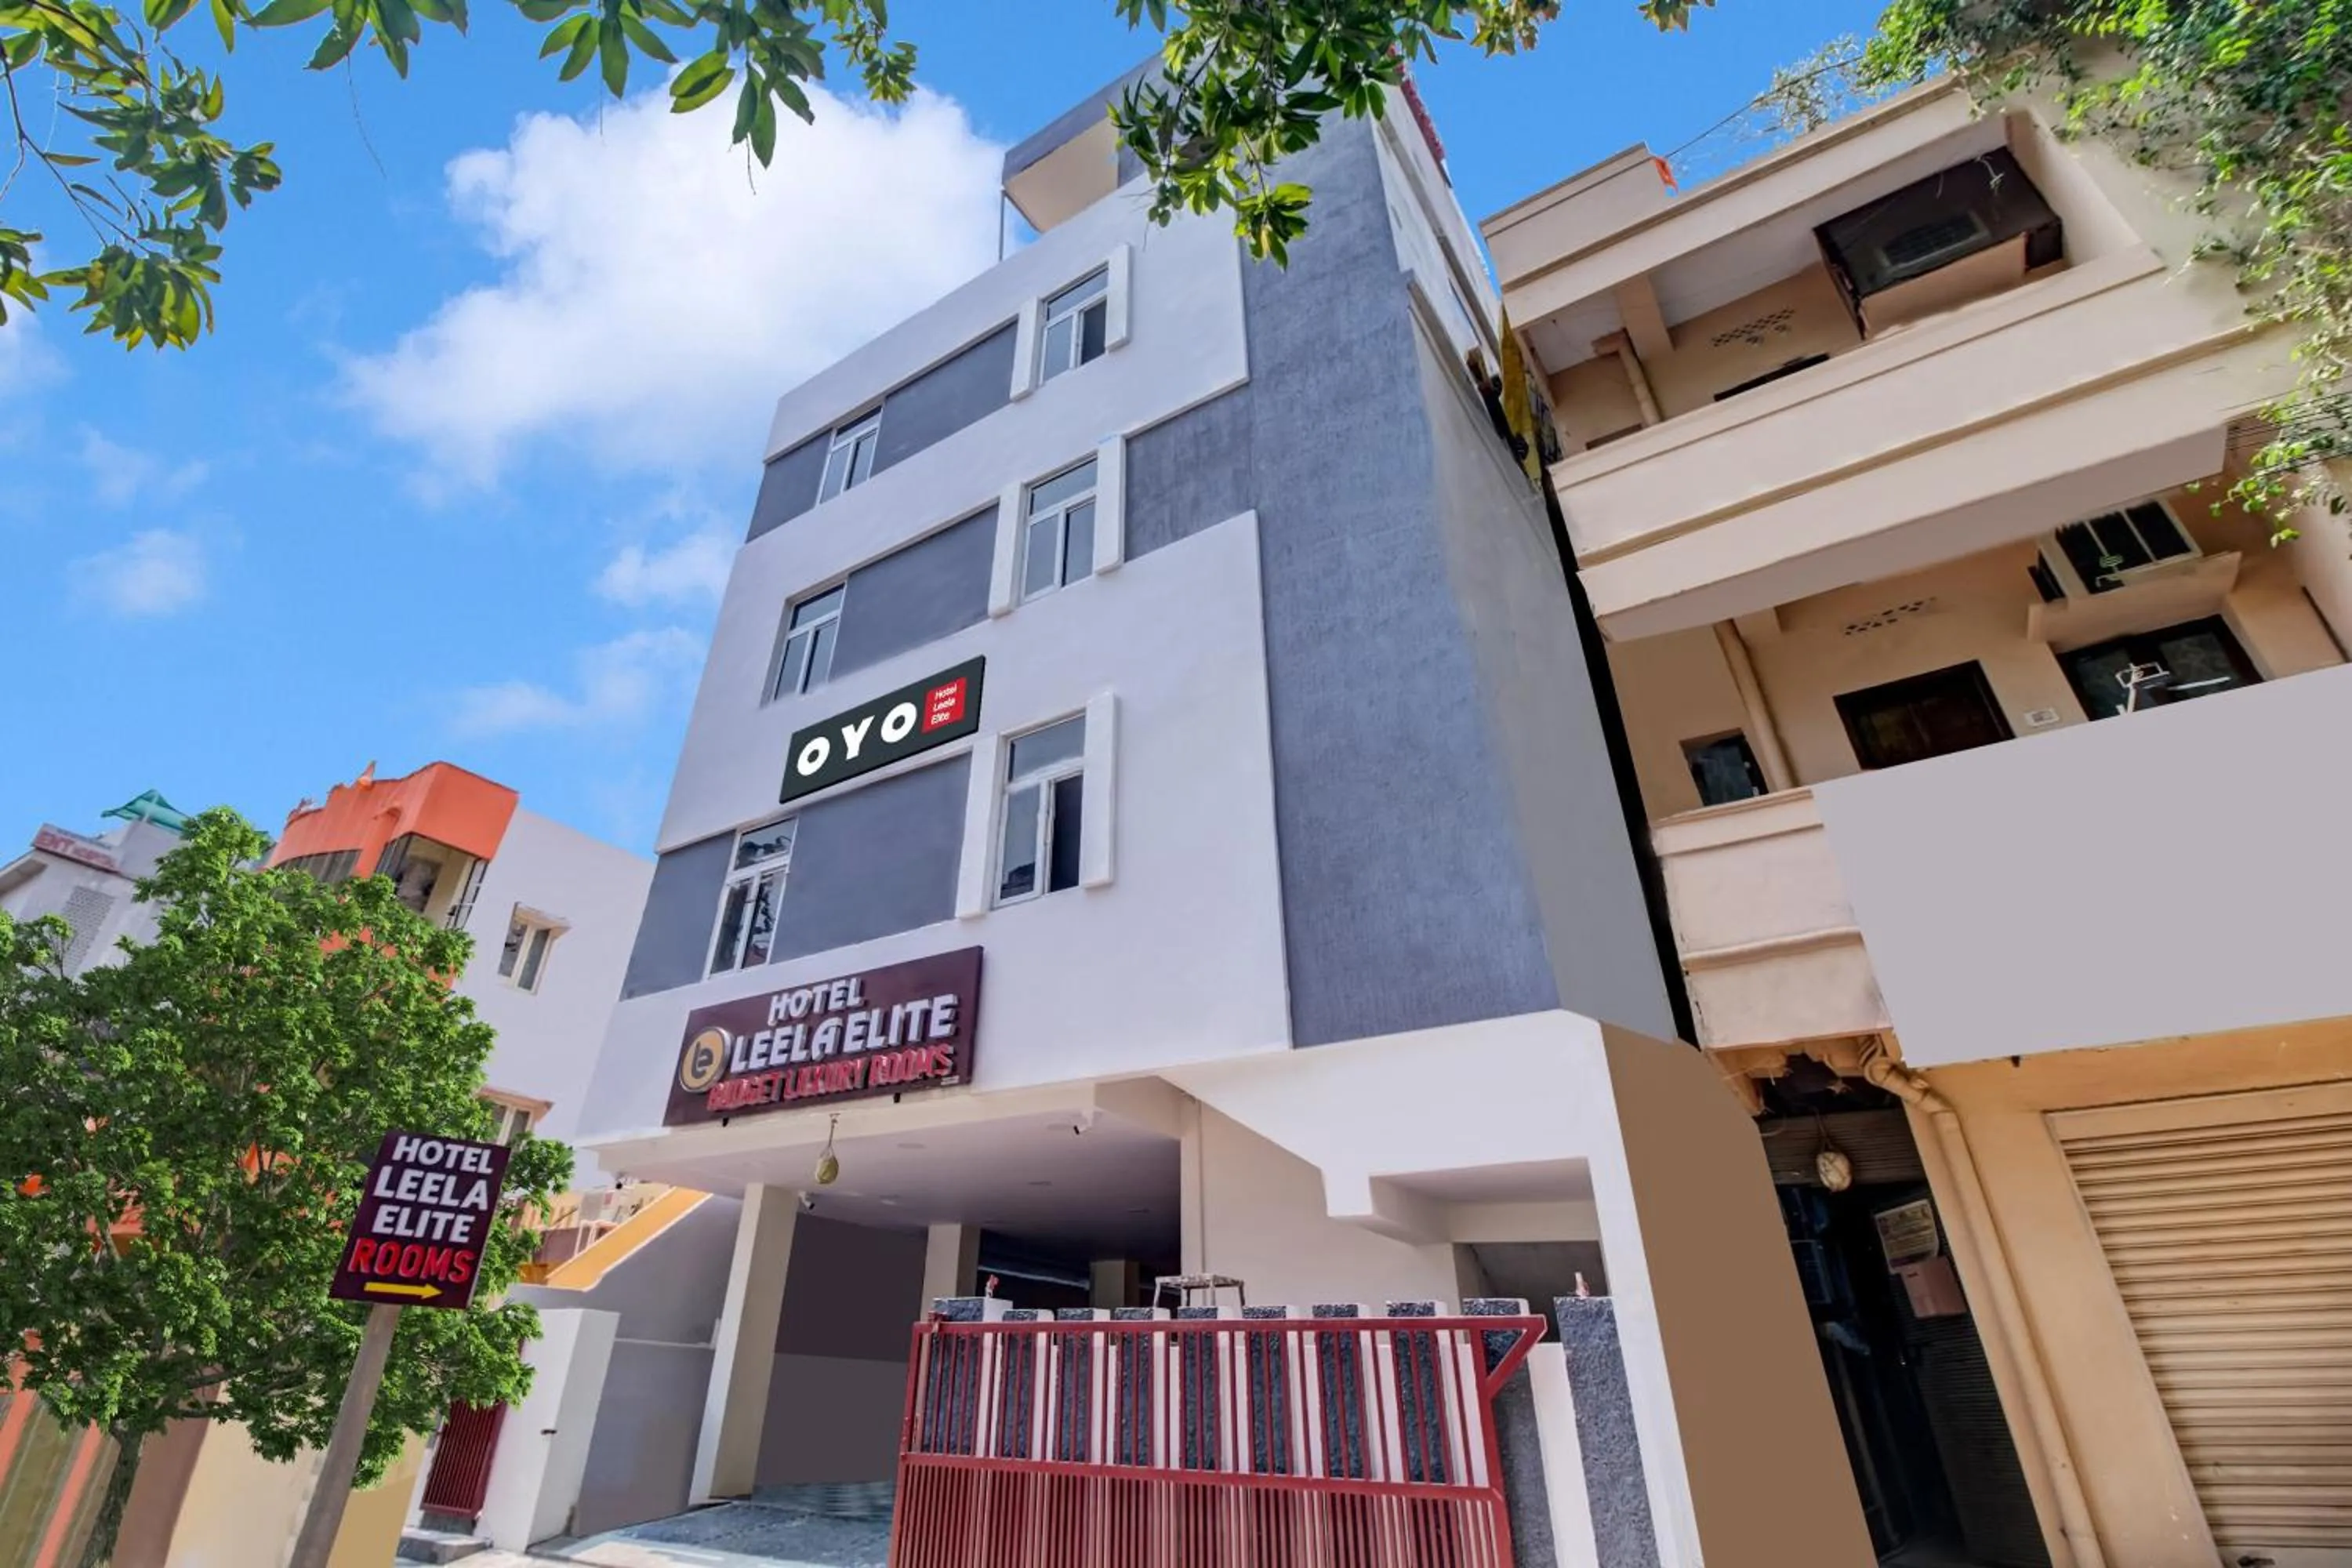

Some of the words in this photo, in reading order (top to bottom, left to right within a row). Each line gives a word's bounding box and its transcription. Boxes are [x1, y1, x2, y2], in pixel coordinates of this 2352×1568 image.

[935, 683, 957, 700] Hotel
[797, 702, 917, 776] OYO
[768, 978, 862, 1025] HOTEL
[730, 1017, 844, 1073] LEELA
[843, 993, 960, 1054] ELITE
[707, 1071, 784, 1112] BUDGET
[782, 1056, 866, 1099] LUXURY
[868, 1043, 954, 1086] ROOMS
[392, 1136, 494, 1174] HOTEL
[373, 1165, 488, 1211] LEELA
[372, 1204, 476, 1243] ELITE
[347, 1236, 476, 1283] ROOMS
